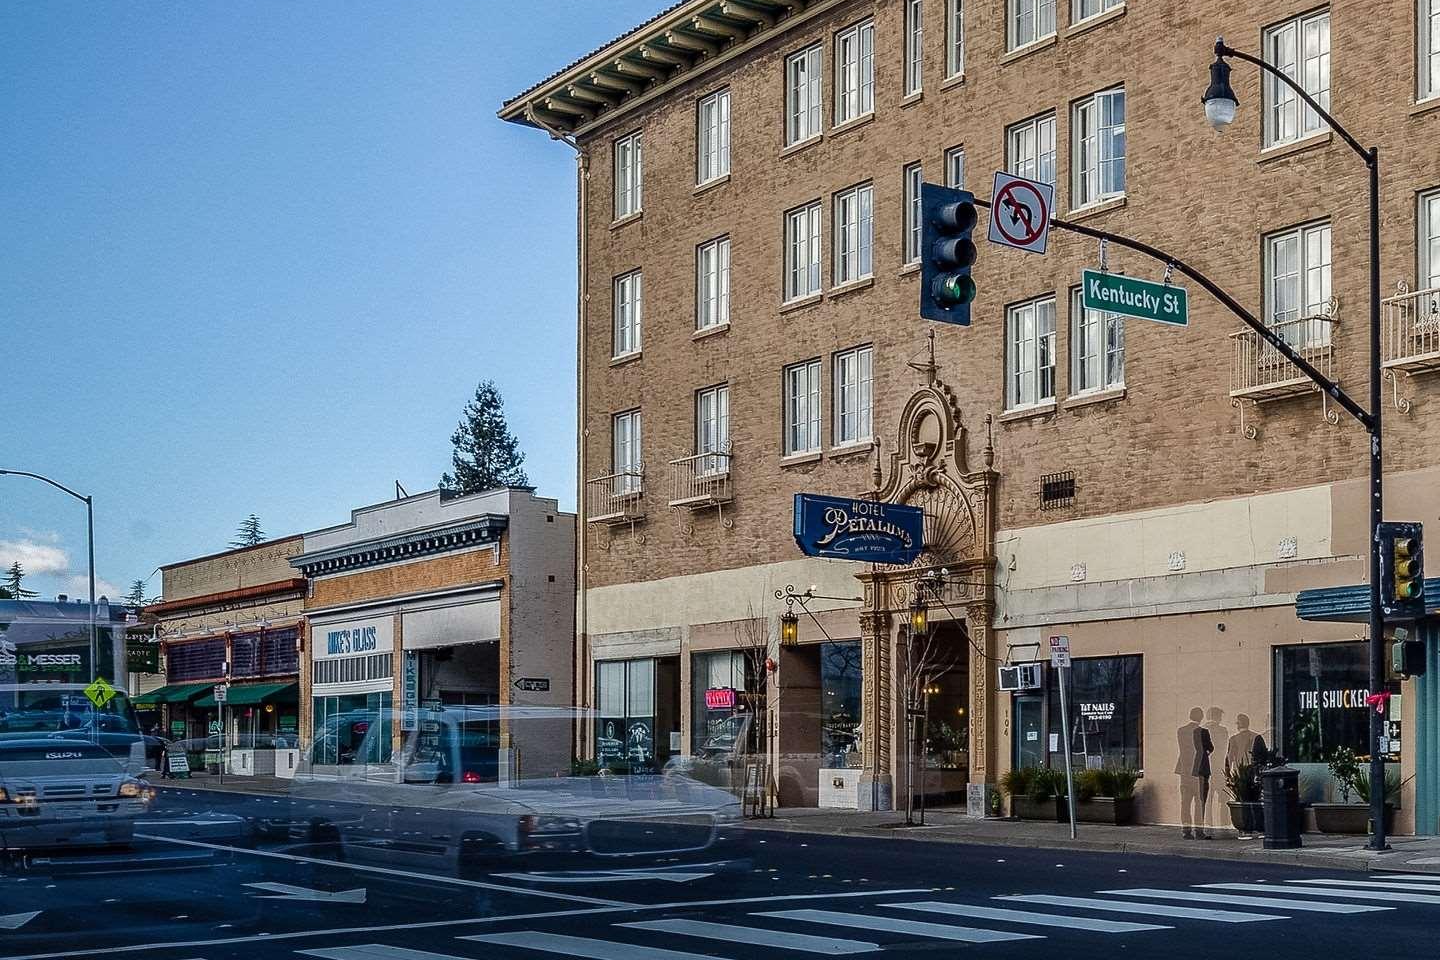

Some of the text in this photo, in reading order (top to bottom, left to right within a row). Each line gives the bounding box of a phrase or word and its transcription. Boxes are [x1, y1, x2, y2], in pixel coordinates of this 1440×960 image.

[1090, 279, 1180, 314] Kentucky St
[852, 502, 885, 516] HOTEL
[328, 627, 376, 654] MIKE'S GLASS
[27, 654, 82, 665] MESSER
[1300, 689, 1370, 708] THE SHUCKER
[1092, 702, 1115, 712] NAILS
[45, 751, 82, 760] ISUZU
